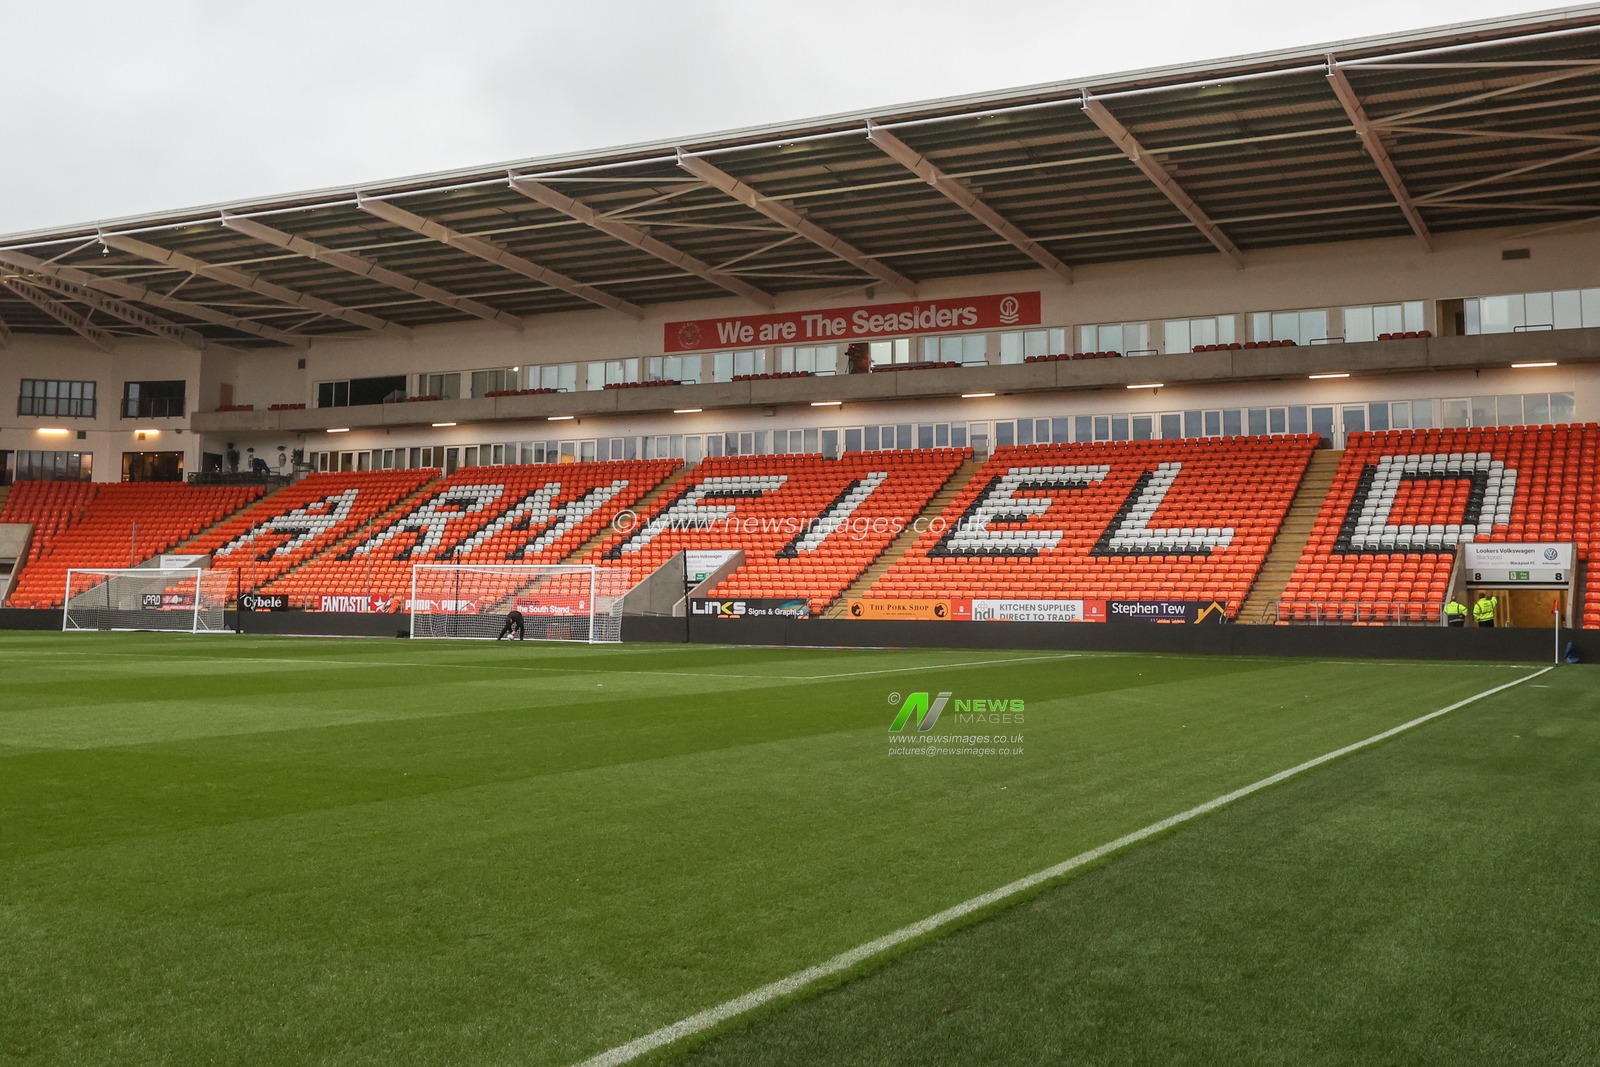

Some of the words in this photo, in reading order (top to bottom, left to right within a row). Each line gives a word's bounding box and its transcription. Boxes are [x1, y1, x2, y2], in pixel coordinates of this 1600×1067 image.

[716, 321, 754, 344] We
[758, 319, 796, 341] are
[801, 313, 847, 338] The
[852, 304, 978, 334] Seasiders
[1474, 572, 1482, 581] 8
[1555, 572, 1563, 581] 8
[321, 595, 371, 612] FANTASTIC
[887, 603, 907, 611] PORK
[1000, 603, 1036, 611] KITCHEN
[1037, 603, 1076, 611] SUPPLIES
[517, 604, 528, 613] the
[529, 605, 548, 613] South
[550, 605, 570, 613] Stand
[748, 608, 767, 616] Signs
[1111, 602, 1159, 617] Stephen
[1160, 603, 1186, 614] Tew
[974, 607, 995, 621] hdl
[1000, 613, 1030, 621] DIRECT
[1033, 613, 1045, 621] TO
[1047, 613, 1076, 621] TRADE
